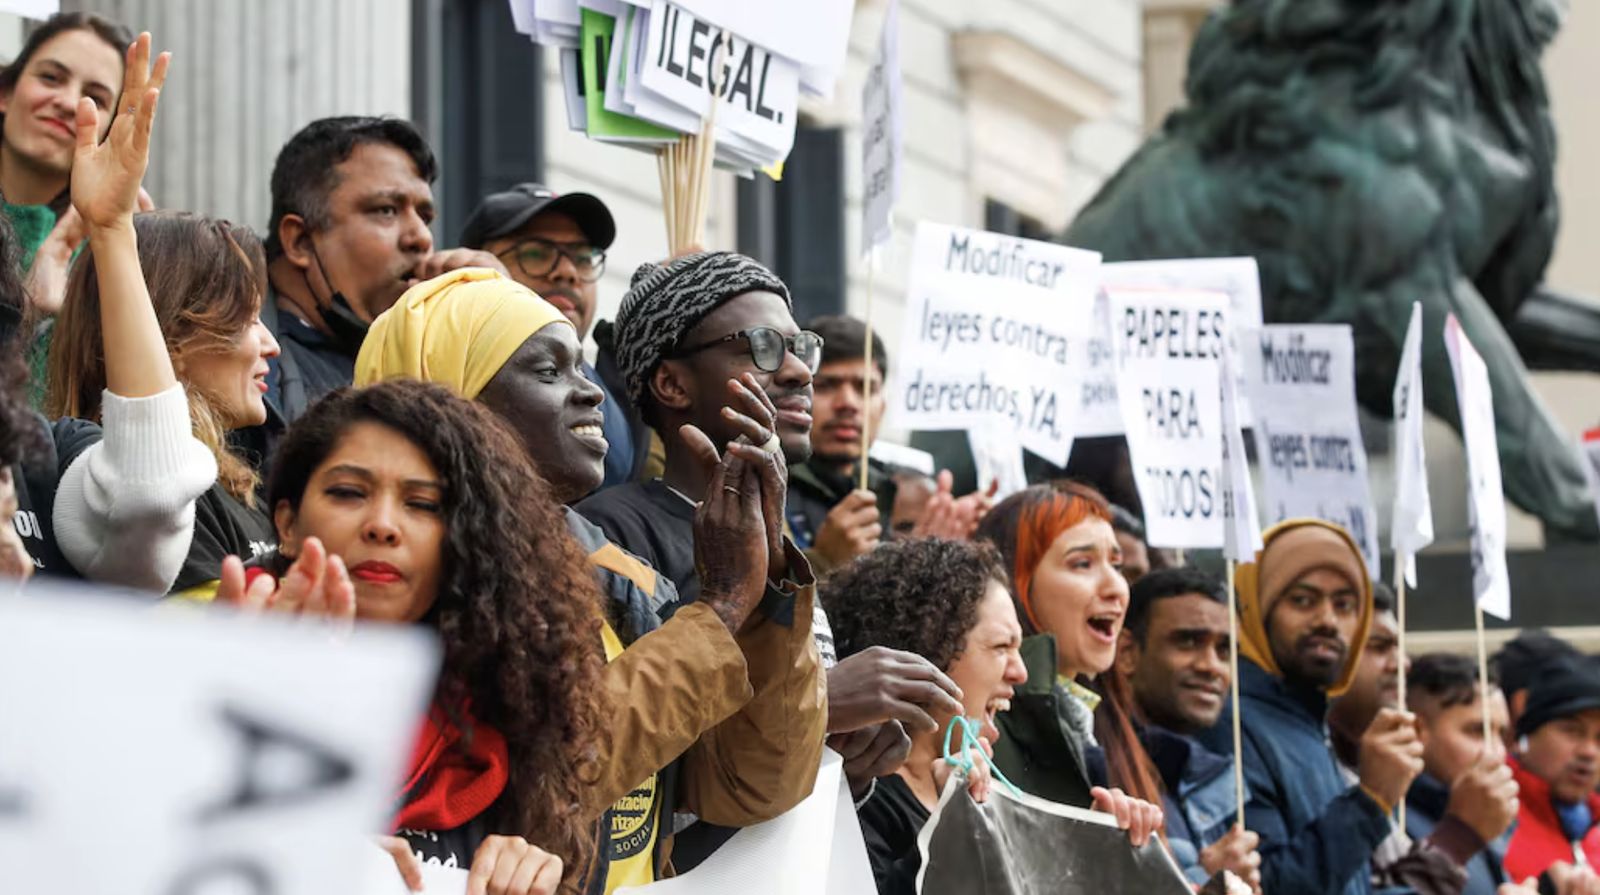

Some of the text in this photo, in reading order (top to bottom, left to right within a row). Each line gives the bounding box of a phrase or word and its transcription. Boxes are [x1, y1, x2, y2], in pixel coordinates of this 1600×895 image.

[657, 4, 784, 125] ILEGAL.
[945, 232, 1065, 289] Modificar
[920, 297, 983, 353] leyes
[990, 314, 1069, 365] contra
[1143, 388, 1205, 440] PARA
[615, 824, 650, 854] SOCIAL
